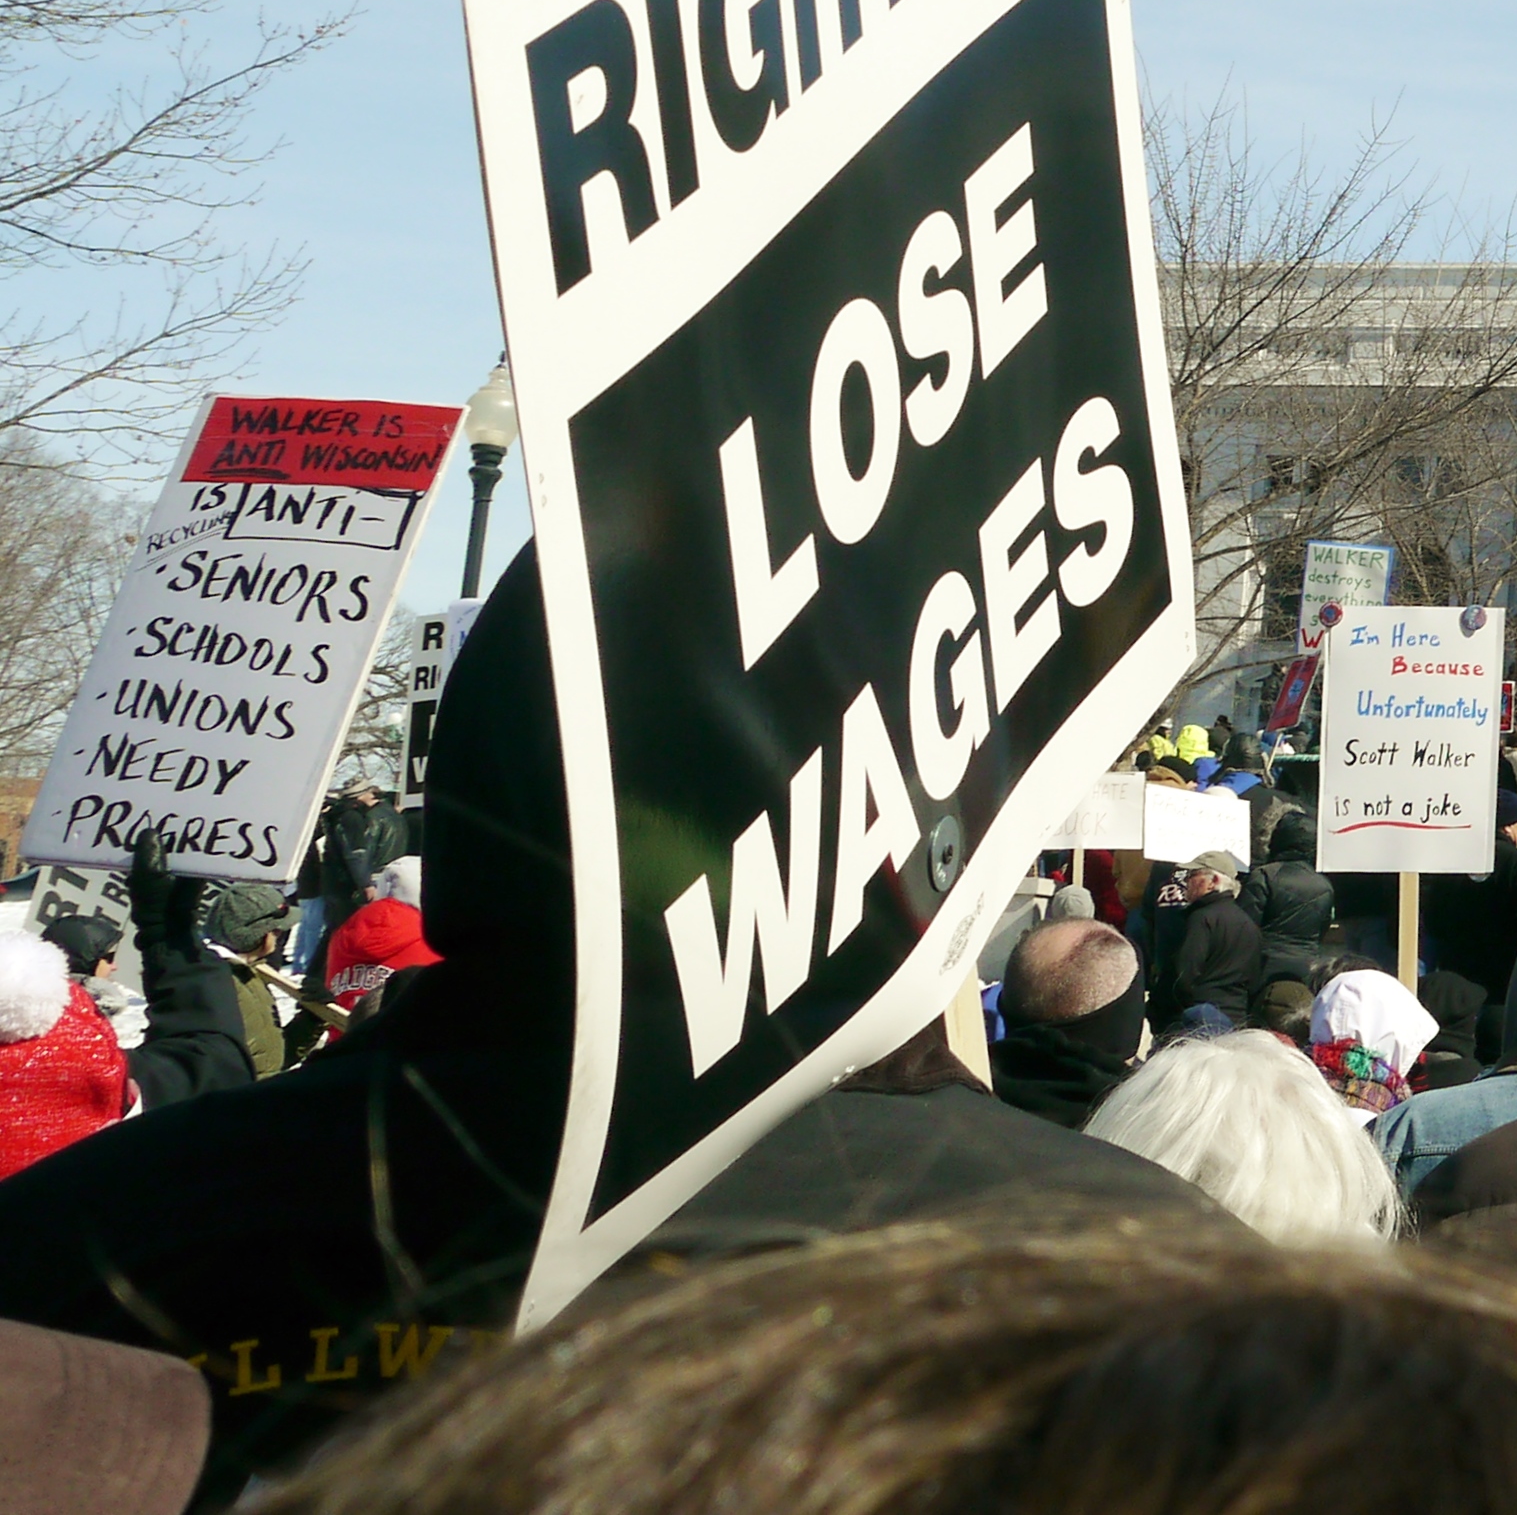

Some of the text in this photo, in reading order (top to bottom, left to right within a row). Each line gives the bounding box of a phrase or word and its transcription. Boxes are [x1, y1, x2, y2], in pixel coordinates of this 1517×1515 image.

[718, 121, 1049, 672] LOSE
[231, 405, 404, 438] WALKER IS
[209, 439, 443, 472] ANTI WISCONSIN
[190, 482, 228, 512] IS
[1313, 547, 1386, 570] WALKER
[167, 550, 371, 624] SENIORS
[1308, 568, 1372, 591] destroys
[133, 616, 331, 685] SCHOOLS
[1391, 622, 1441, 648] Here
[1391, 655, 1484, 676] Because
[113, 678, 296, 740] UNIONS
[1357, 690, 1489, 726] Unfortunately
[664, 396, 1134, 1080] WAGES
[1343, 739, 1476, 768] Scott Walker
[85, 732, 251, 796] NEEDY
[1335, 793, 1462, 824] is not a joke
